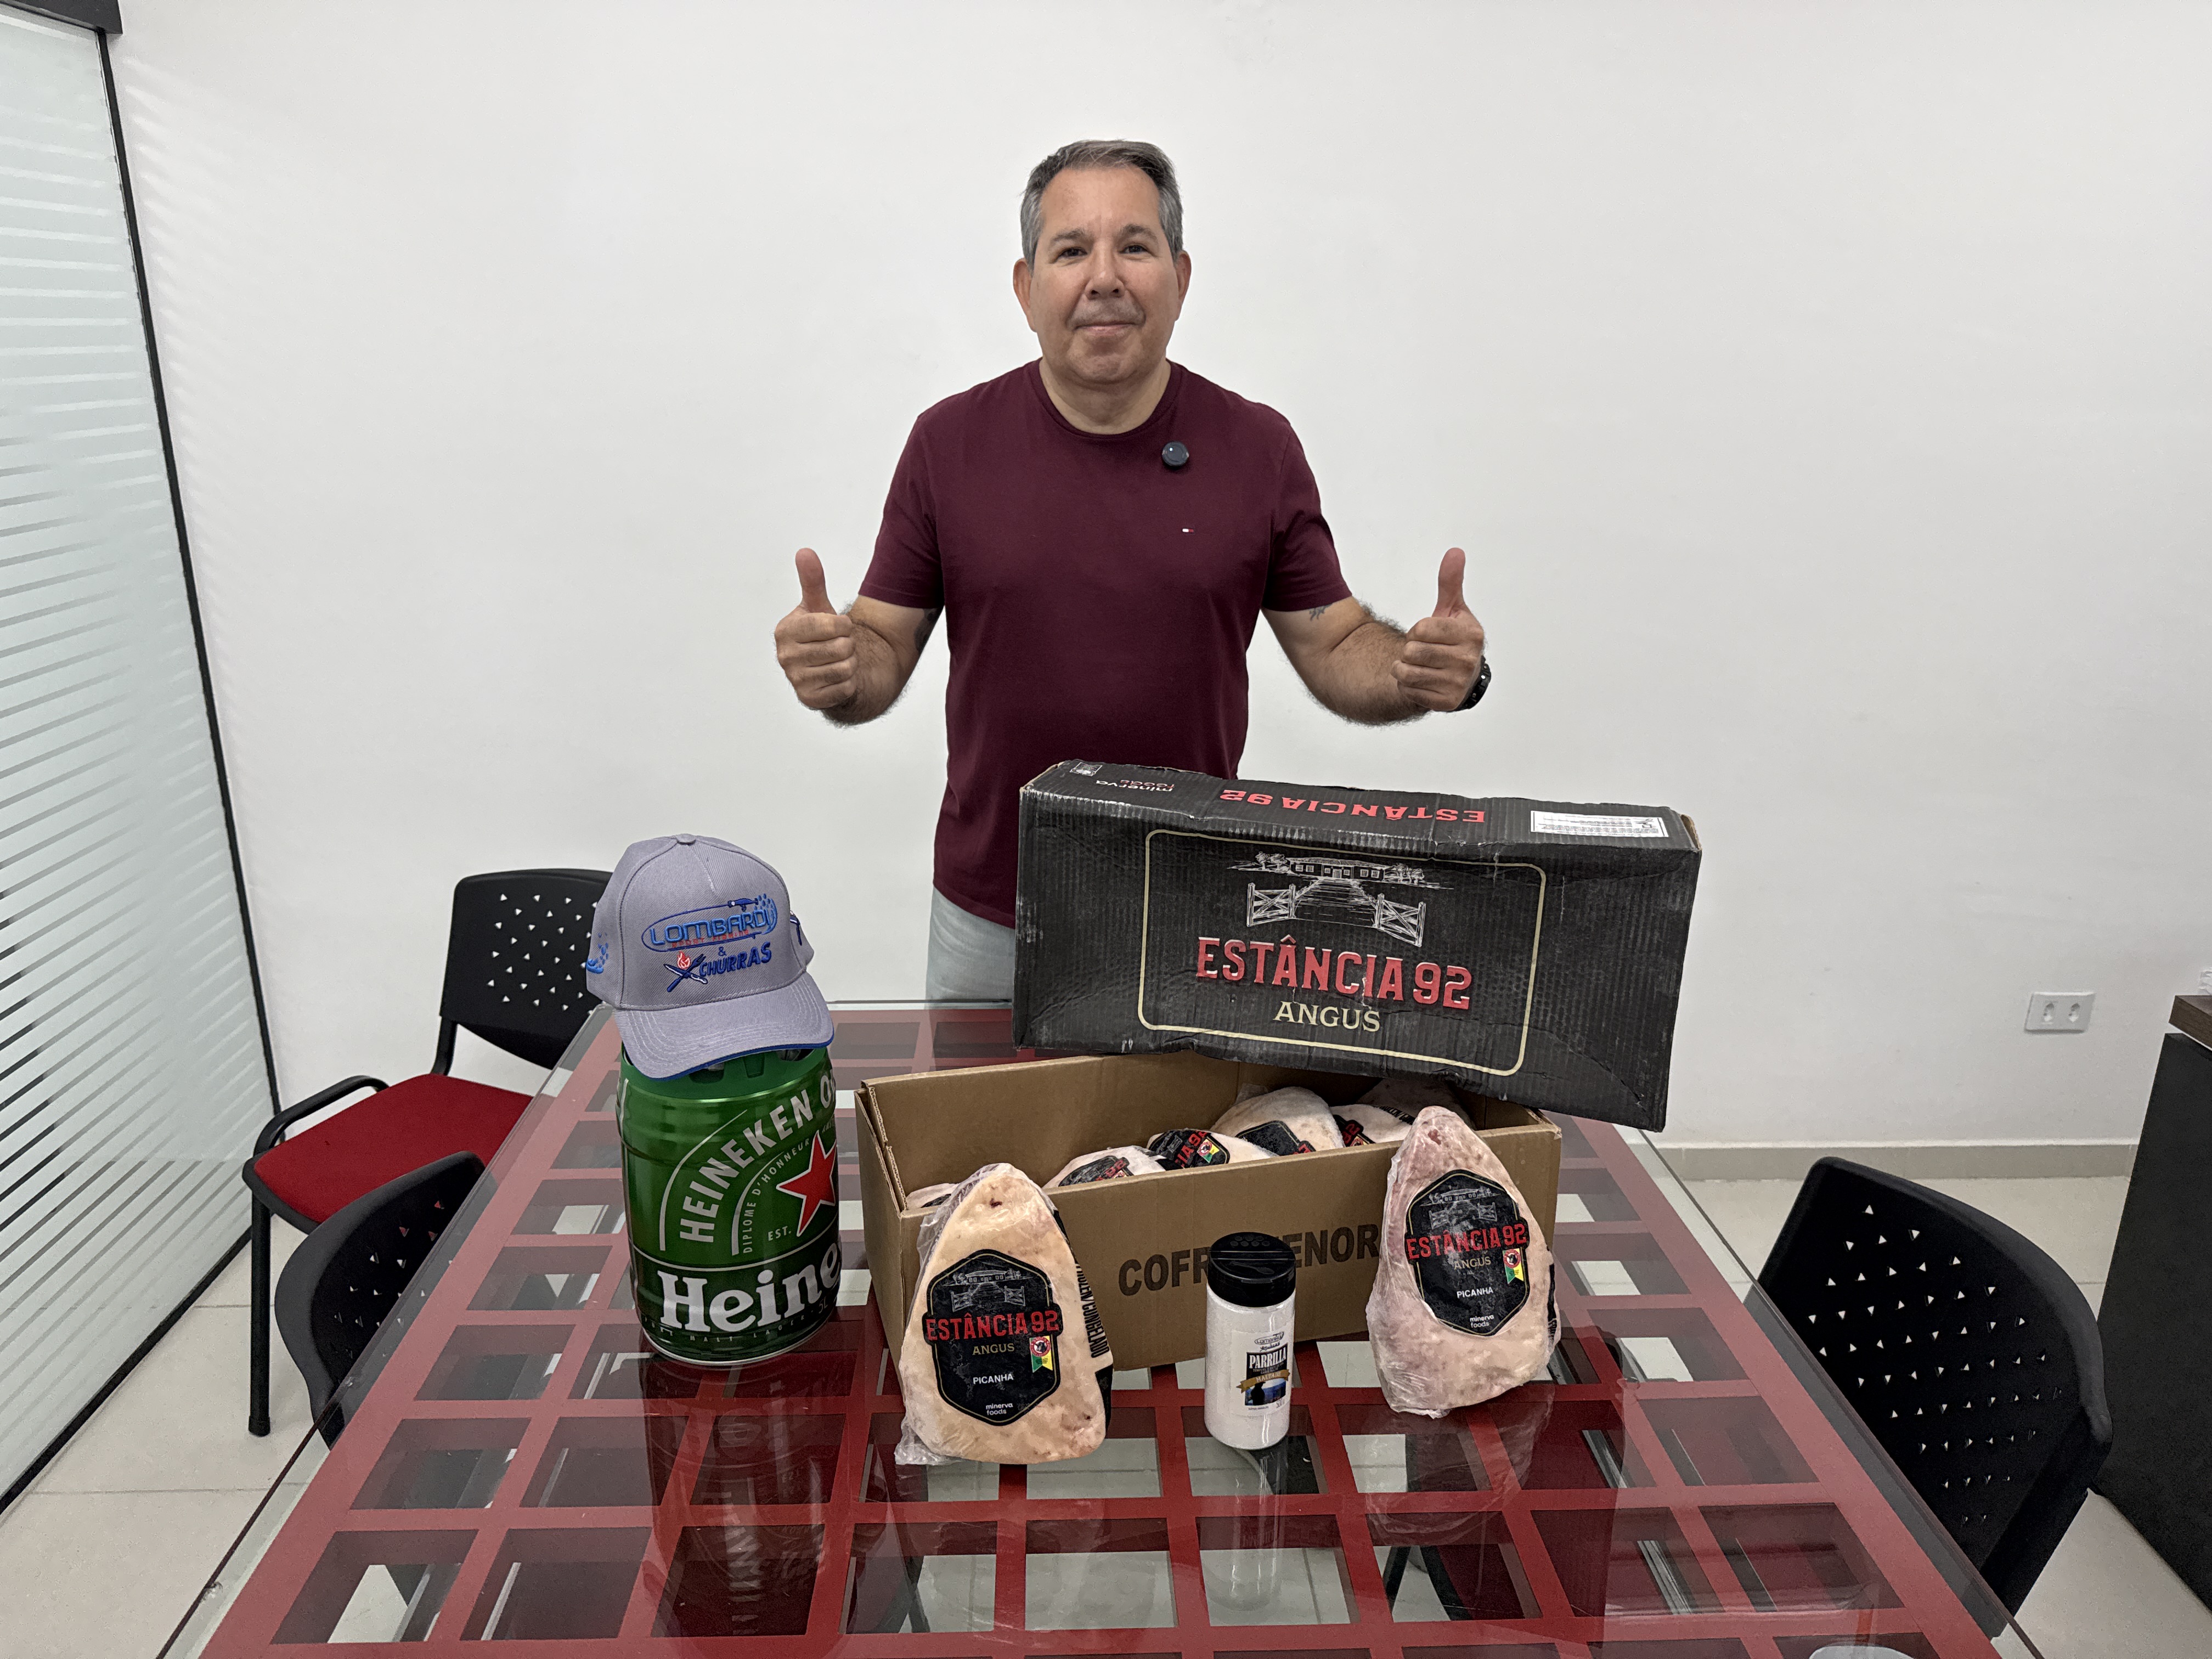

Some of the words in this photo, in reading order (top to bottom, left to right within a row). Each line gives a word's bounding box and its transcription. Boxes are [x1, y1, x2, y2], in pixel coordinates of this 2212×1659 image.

[1096, 780, 1175, 792] minerva
[1219, 789, 1274, 805] 92
[1282, 797, 1486, 823] ESTÂNCIA
[650, 909, 770, 945] LOMBARDI
[699, 941, 772, 977] CHURRAS
[718, 946, 727, 956] &
[1195, 934, 1404, 1001] ESTÂNCIA
[1412, 962, 1472, 1010] 92
[1273, 1000, 1381, 1032] ANGUS
[680, 1089, 814, 1243] HEINEKEN
[742, 1202, 756, 1253] DIPLOME
[752, 1138, 809, 1196] D'HONNEUR
[768, 1226, 792, 1241] EST.
[1406, 1228, 1501, 1260] ESTÂNCIA
[1502, 1223, 1527, 1246] 92
[1118, 1246, 1209, 1296] COFR
[1274, 1224, 1380, 1269] ENOR
[1454, 1256, 1492, 1270] ANGUS
[657, 1242, 839, 1332] Heine
[1457, 1286, 1494, 1299] PICANHA
[926, 1312, 1029, 1341] ESTÂNCIA
[1030, 1310, 1059, 1333] 92
[1470, 1314, 1494, 1323] minerva
[972, 1343, 1015, 1356] ANGUS
[1249, 1347, 1286, 1369] PARRILLA
[973, 1373, 1014, 1385] PICANHA
